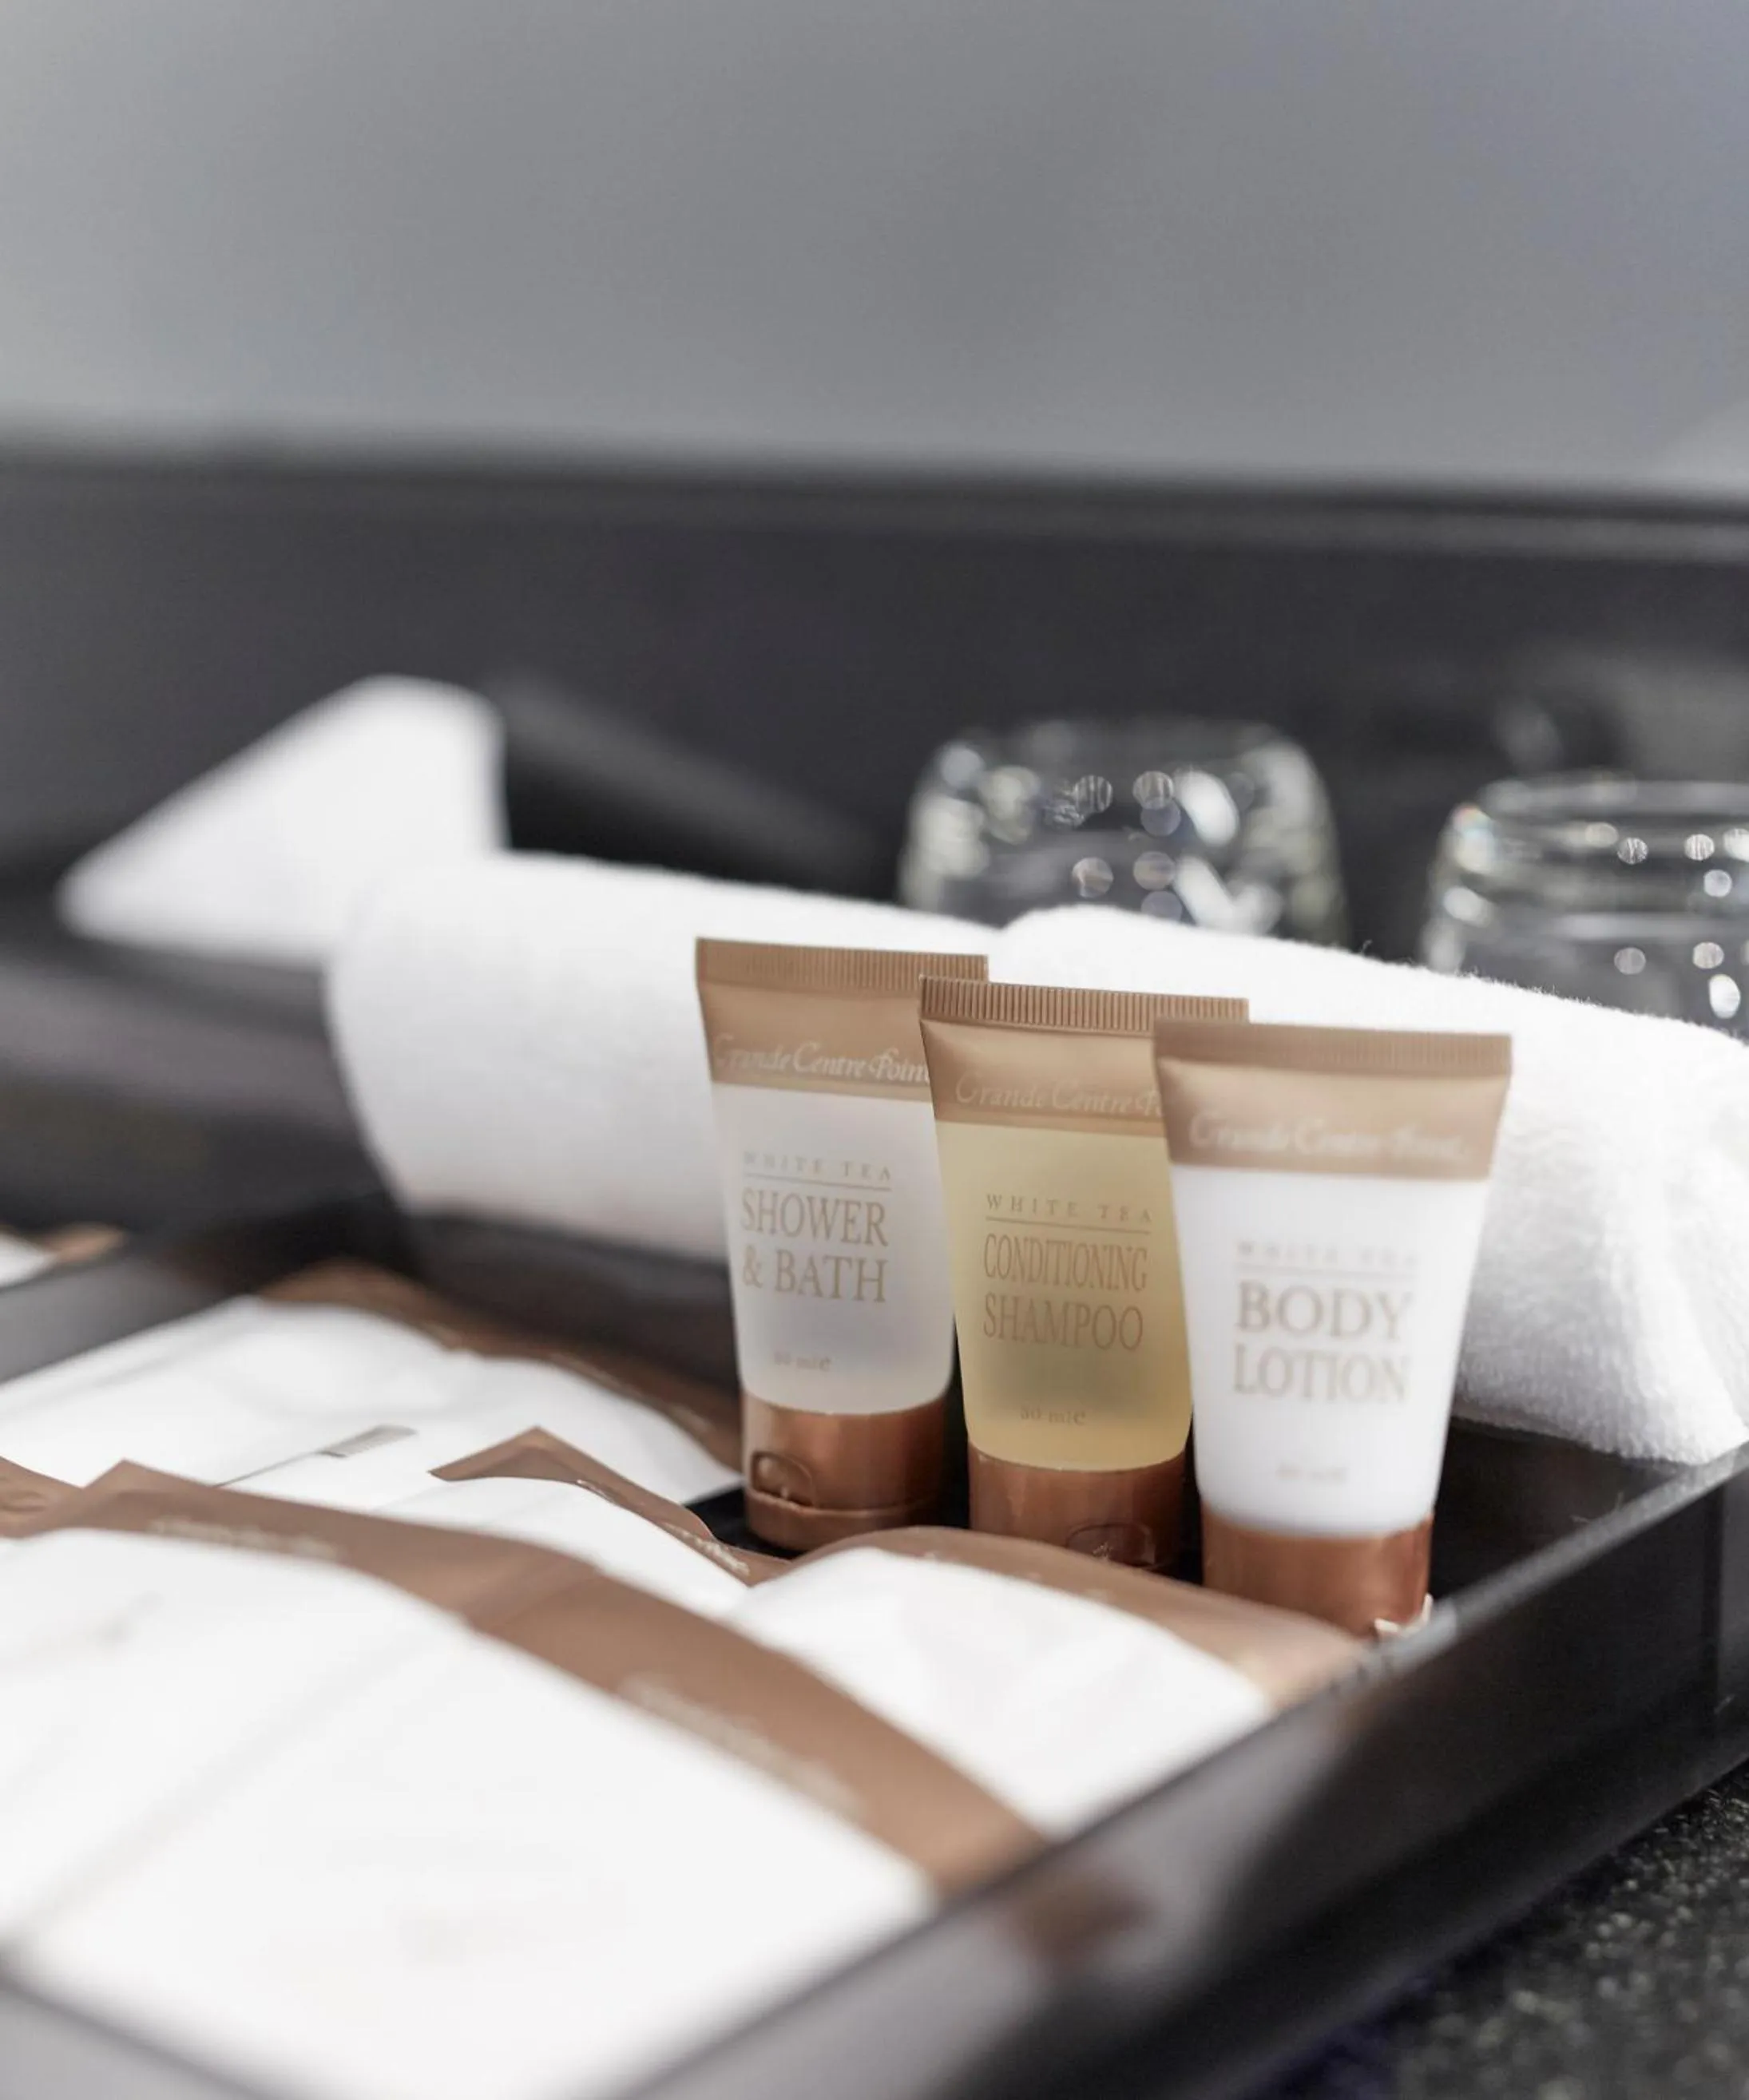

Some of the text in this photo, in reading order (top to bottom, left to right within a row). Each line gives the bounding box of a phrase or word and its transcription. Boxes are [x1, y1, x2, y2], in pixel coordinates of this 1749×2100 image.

[794, 1040, 867, 1079] Centre
[842, 1161, 891, 1181] TEA
[741, 1187, 889, 1247] SHOWER
[986, 1193, 1152, 1223] WHITE TEA
[741, 1244, 890, 1304] & BATH
[983, 1232, 1148, 1293] CONDITIONING
[982, 1291, 1144, 1351] SHAMPOO
[1235, 1280, 1414, 1340] BODY
[1233, 1342, 1412, 1404] LOTION
